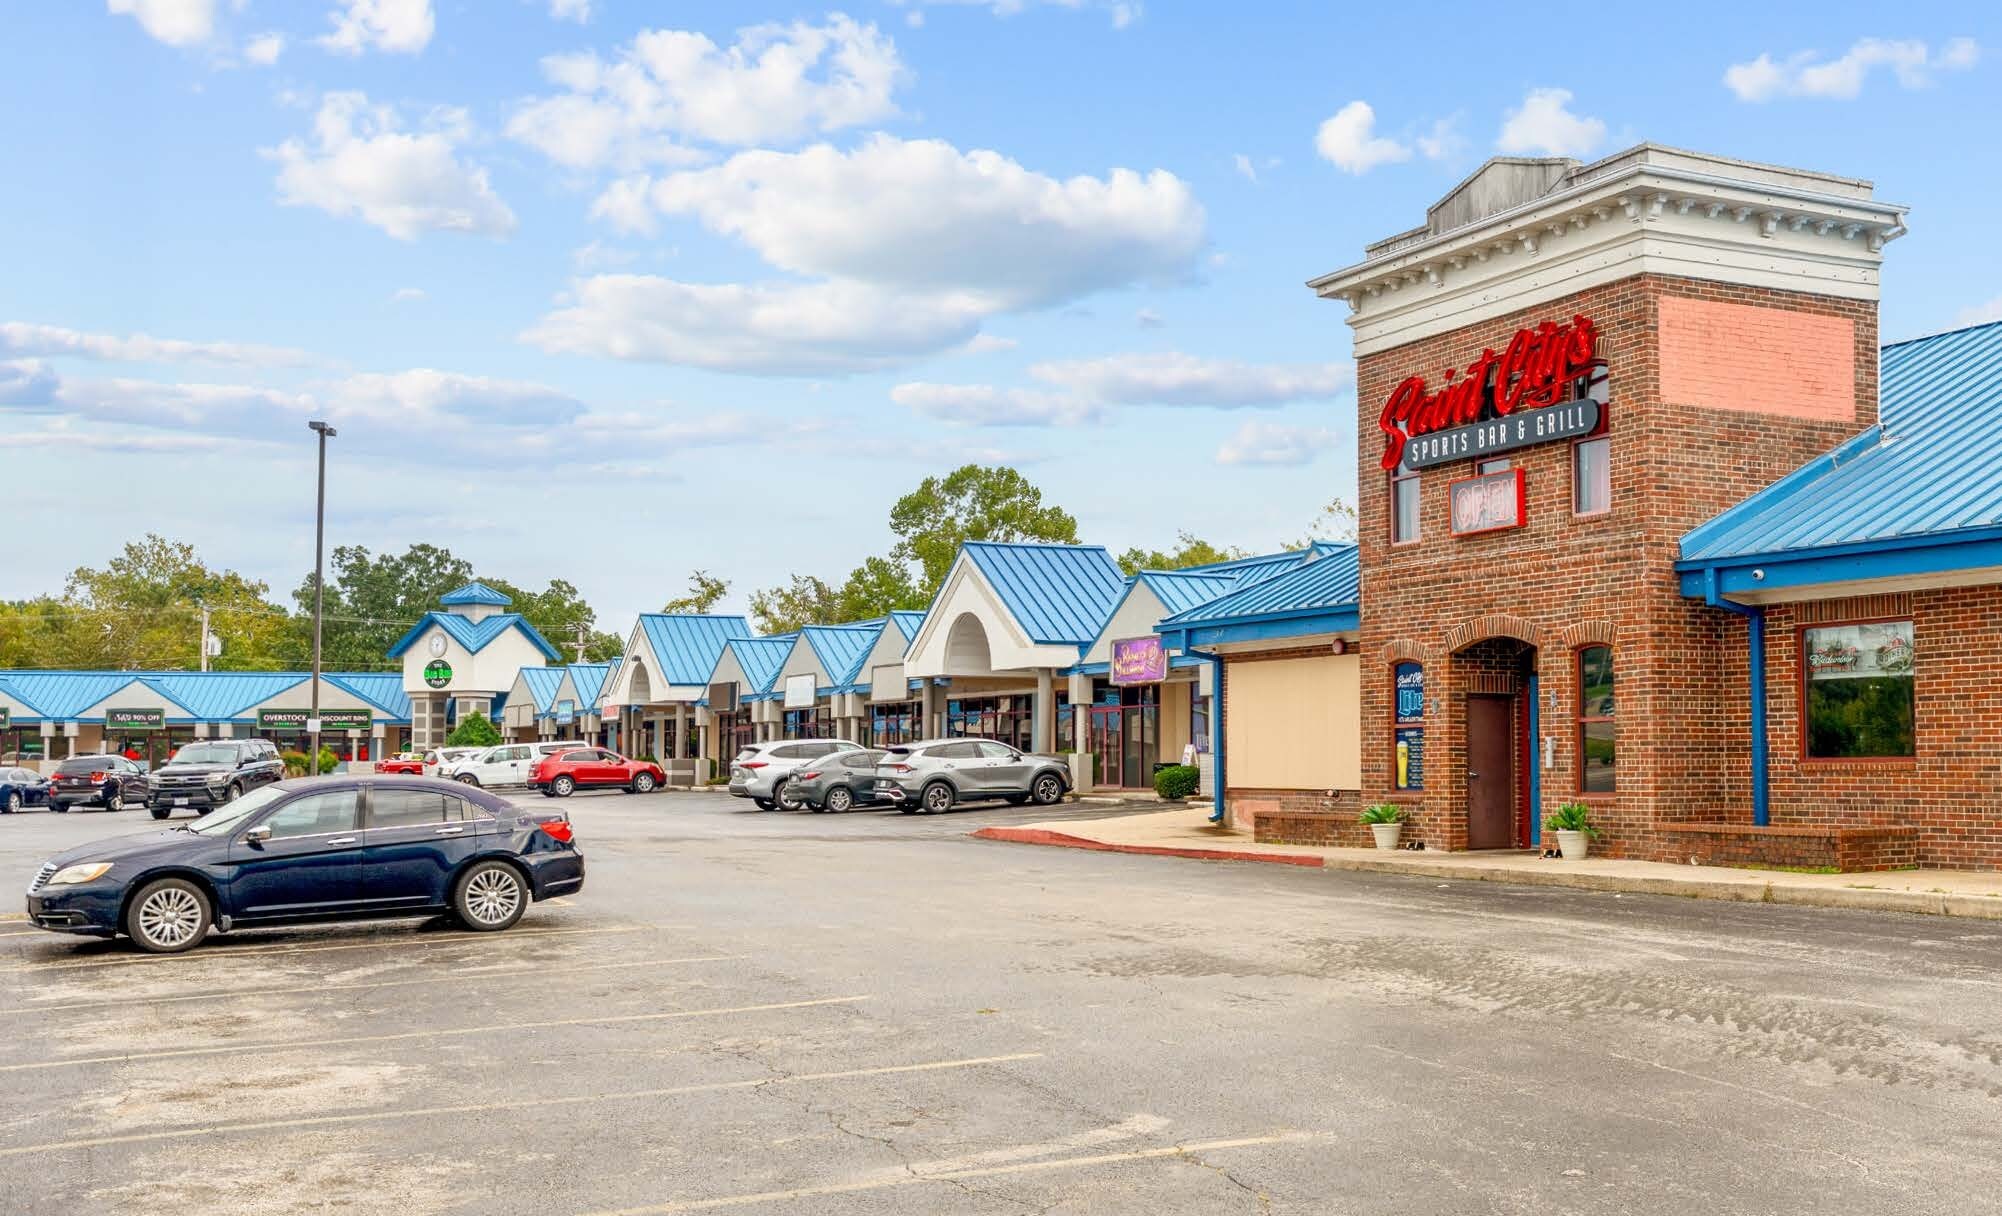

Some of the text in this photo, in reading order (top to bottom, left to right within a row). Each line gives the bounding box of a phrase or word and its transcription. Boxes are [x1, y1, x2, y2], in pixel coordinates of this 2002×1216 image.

[1379, 314, 1598, 471] Saint City's
[1411, 406, 1585, 463] SPORTS BAR & GRILL
[1454, 479, 1517, 529] OPEN
